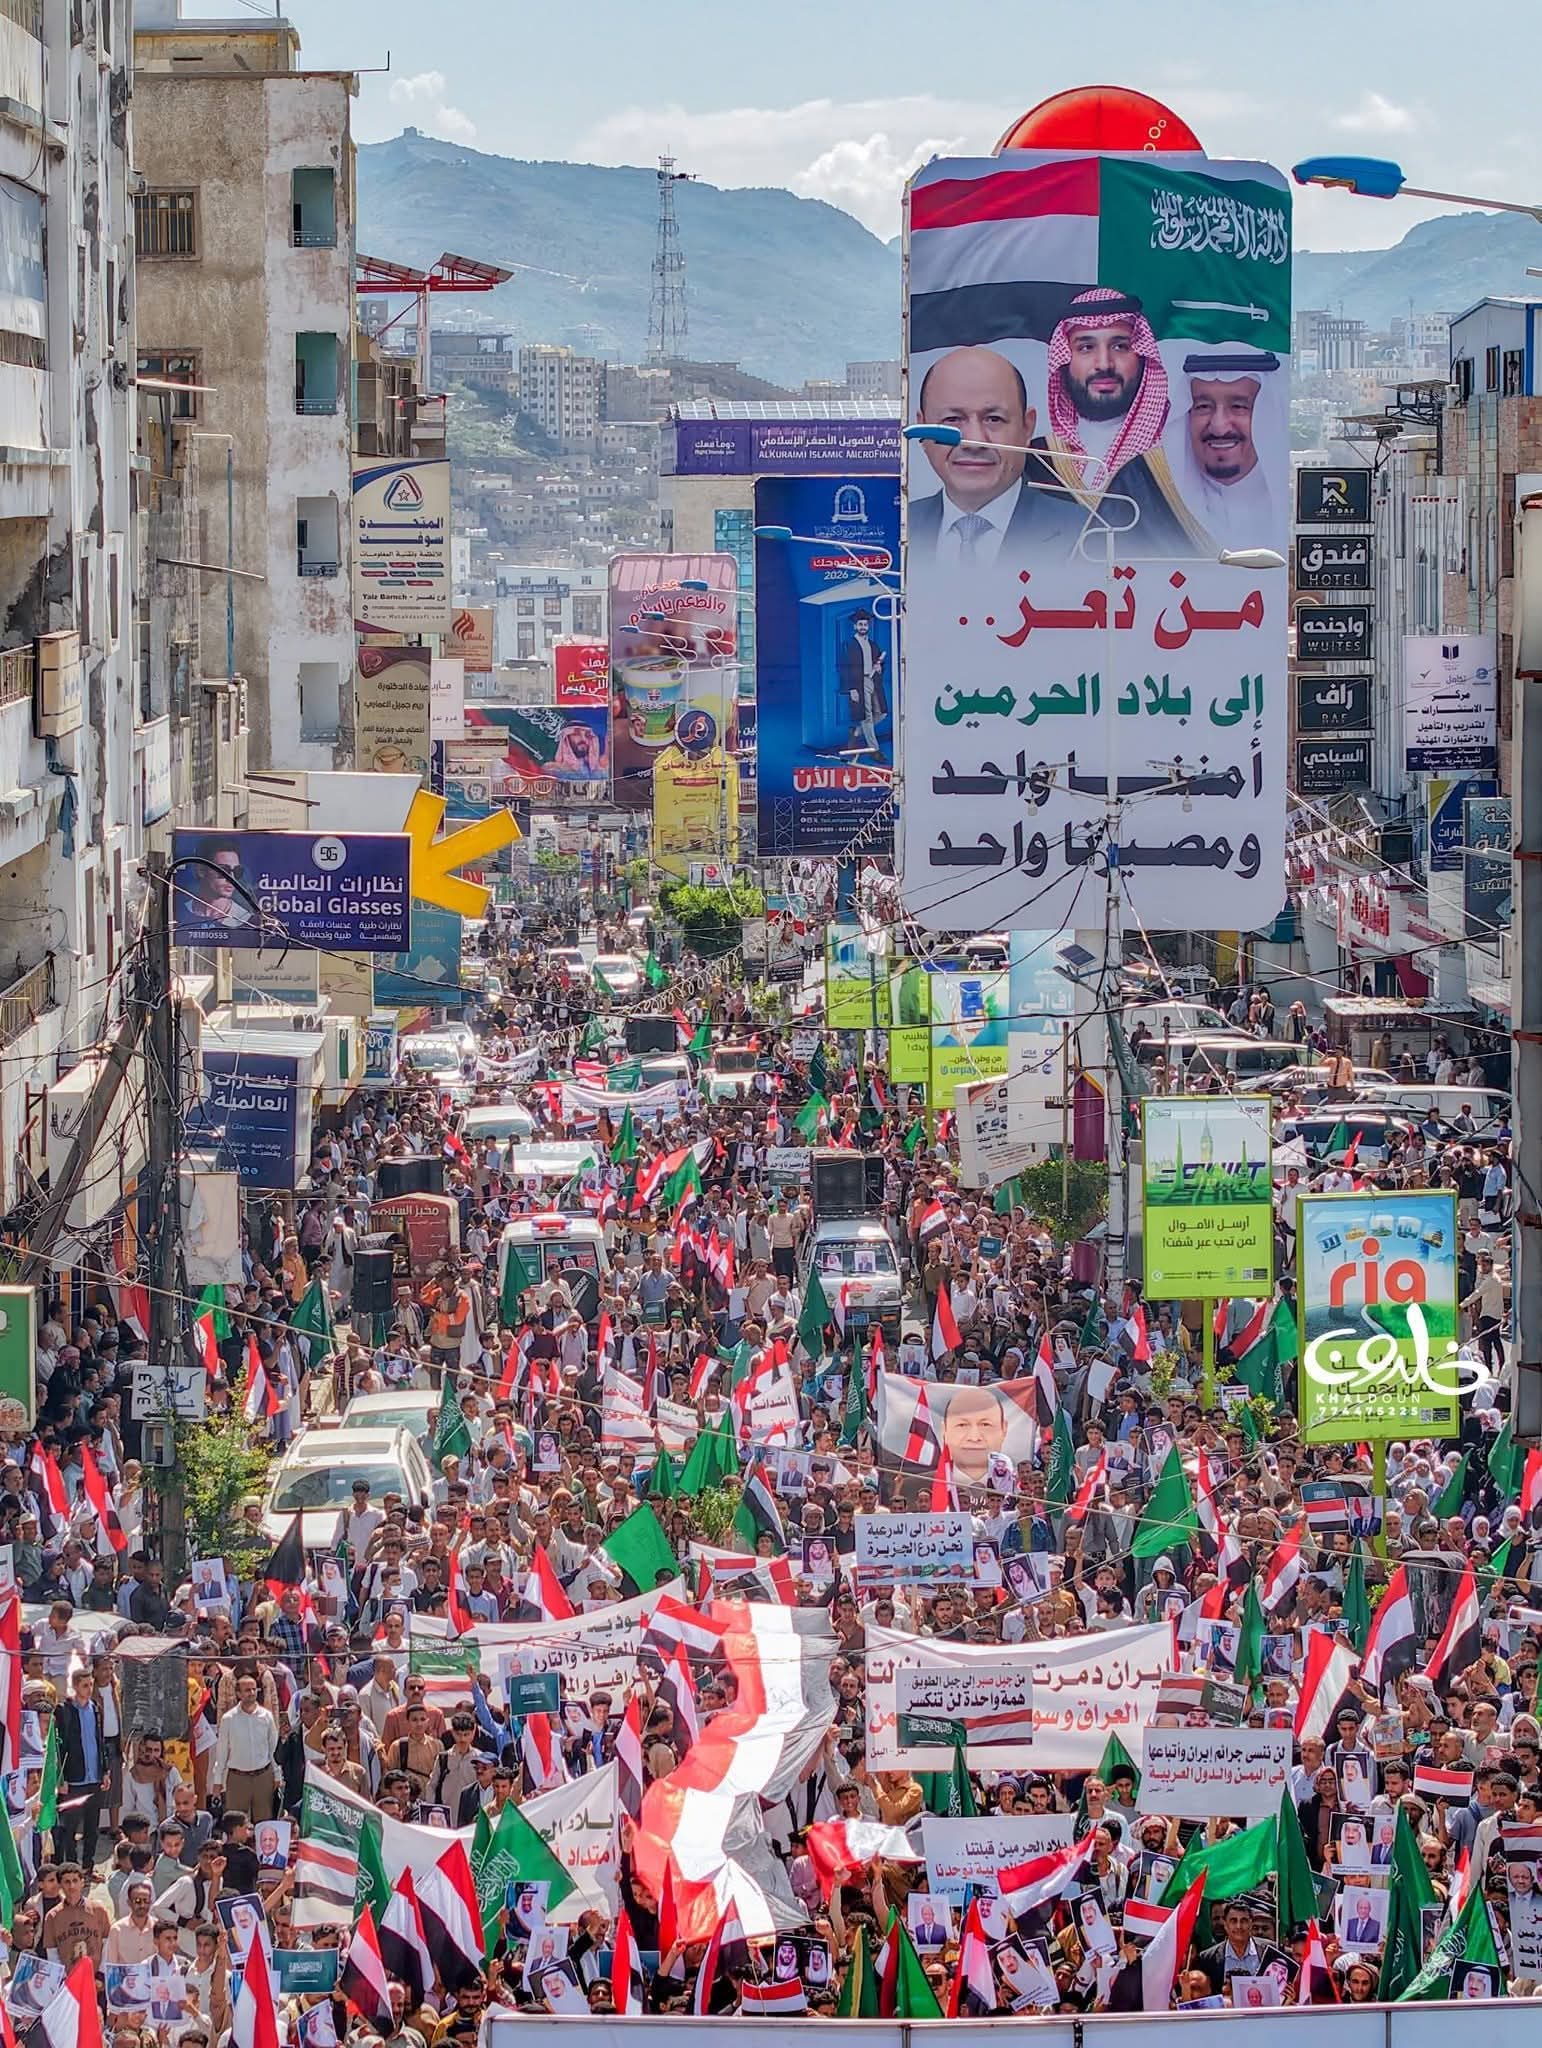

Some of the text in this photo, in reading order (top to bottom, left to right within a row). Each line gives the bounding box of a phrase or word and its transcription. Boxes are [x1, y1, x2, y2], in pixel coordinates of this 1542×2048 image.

[759, 433, 803, 448] الإسلامي
[838, 434, 875, 447] للتمويل
[877, 435, 901, 448] ريمي
[758, 450, 901, 459] ALKURAIMI ISLAMIC MICROFINAN
[359, 516, 443, 529] المتحدة
[359, 531, 443, 547] سوفت
[1301, 543, 1366, 572] فندق
[824, 570, 882, 580] 2026 20
[1307, 573, 1360, 587] HOTEL
[676, 595, 727, 614] والطعم
[1155, 571, 1264, 649] من
[935, 672, 1264, 732] إلى بلاد الحرمين
[1315, 683, 1353, 710] راف
[1418, 720, 1486, 732] للتدريب والتأهيل
[1415, 735, 1489, 746] والاختبارات المهنية
[1303, 748, 1364, 769] السياحي
[933, 749, 1051, 807] واحد
[929, 820, 1049, 878] واحد
[258, 873, 403, 897] نظارات العالمية
[258, 896, 403, 916] Global Glasses
[950, 1066, 977, 1075] urpay
[214, 1073, 288, 1090] نظارات
[213, 1094, 288, 1112] العالمية
[415, 1205, 440, 1217] مخبز
[1168, 1216, 1250, 1232] أرسل الأموال
[1196, 1239, 1212, 1250] عبر
[1214, 1237, 1235, 1247] تحب
[1236, 1236, 1256, 1248] لمن
[1330, 1237, 1426, 1308] ria
[867, 1521, 908, 1538] الدرعية
[928, 1520, 946, 1537] تعز
[948, 1520, 962, 1537] من
[867, 1540, 963, 1558] نحن درع الجزيرة
[534, 1639, 641, 1673] العقيدة والتاري
[943, 1674, 962, 1688] جبل
[976, 1675, 994, 1688] صبر
[995, 1673, 1013, 1688] جبل
[1014, 1674, 1025, 1687] من
[905, 1690, 1026, 1712] همة واحدة لن تنكسر
[1077, 1700, 1138, 1731] العراق
[1148, 1742, 1286, 1763] لن ننسى جرائم إيران وأتباعها
[1148, 1764, 1285, 1787] في اليمن والدول العربية
[998, 1841, 1045, 1858] الحرمين
[935, 1861, 974, 1879] توحدنا
[1520, 1960, 1542, 1969] احد
